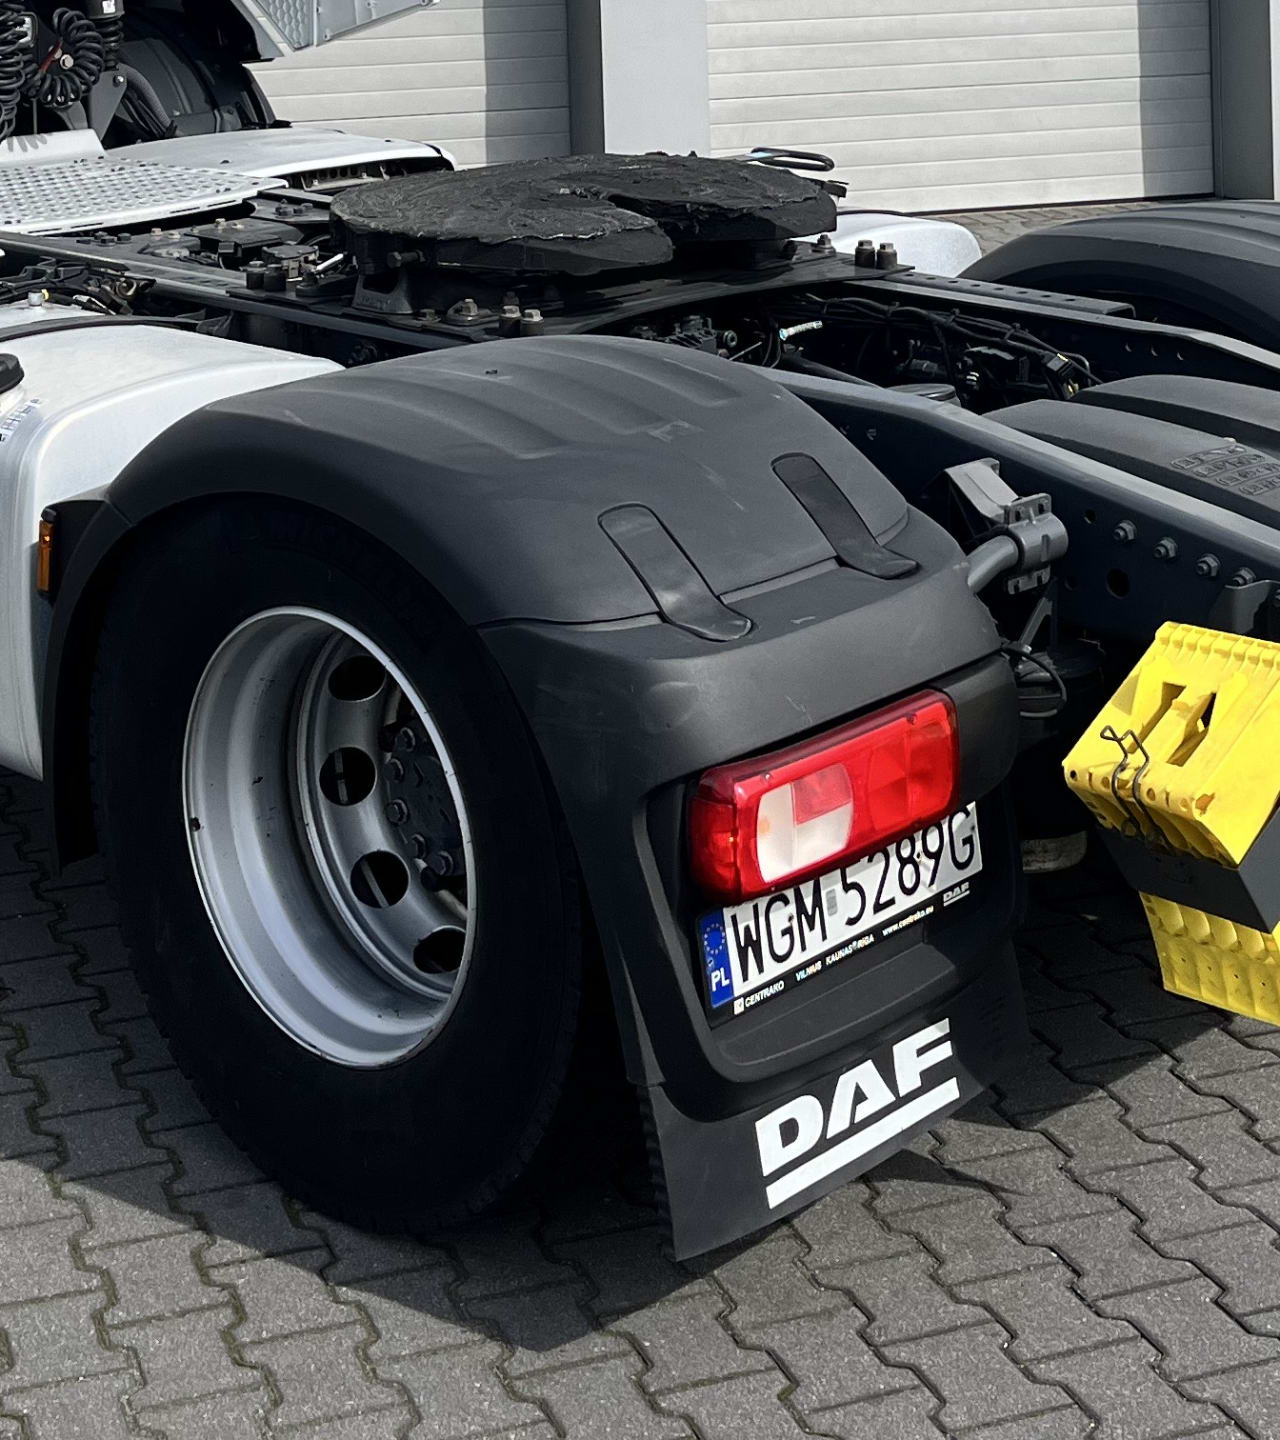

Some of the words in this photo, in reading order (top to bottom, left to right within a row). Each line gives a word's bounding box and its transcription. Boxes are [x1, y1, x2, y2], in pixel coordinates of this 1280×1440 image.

[731, 879, 828, 982] WGM
[840, 810, 975, 926] 5289G
[943, 881, 970, 902] DAF
[711, 967, 730, 992] PL
[755, 1018, 953, 1177] DAF
